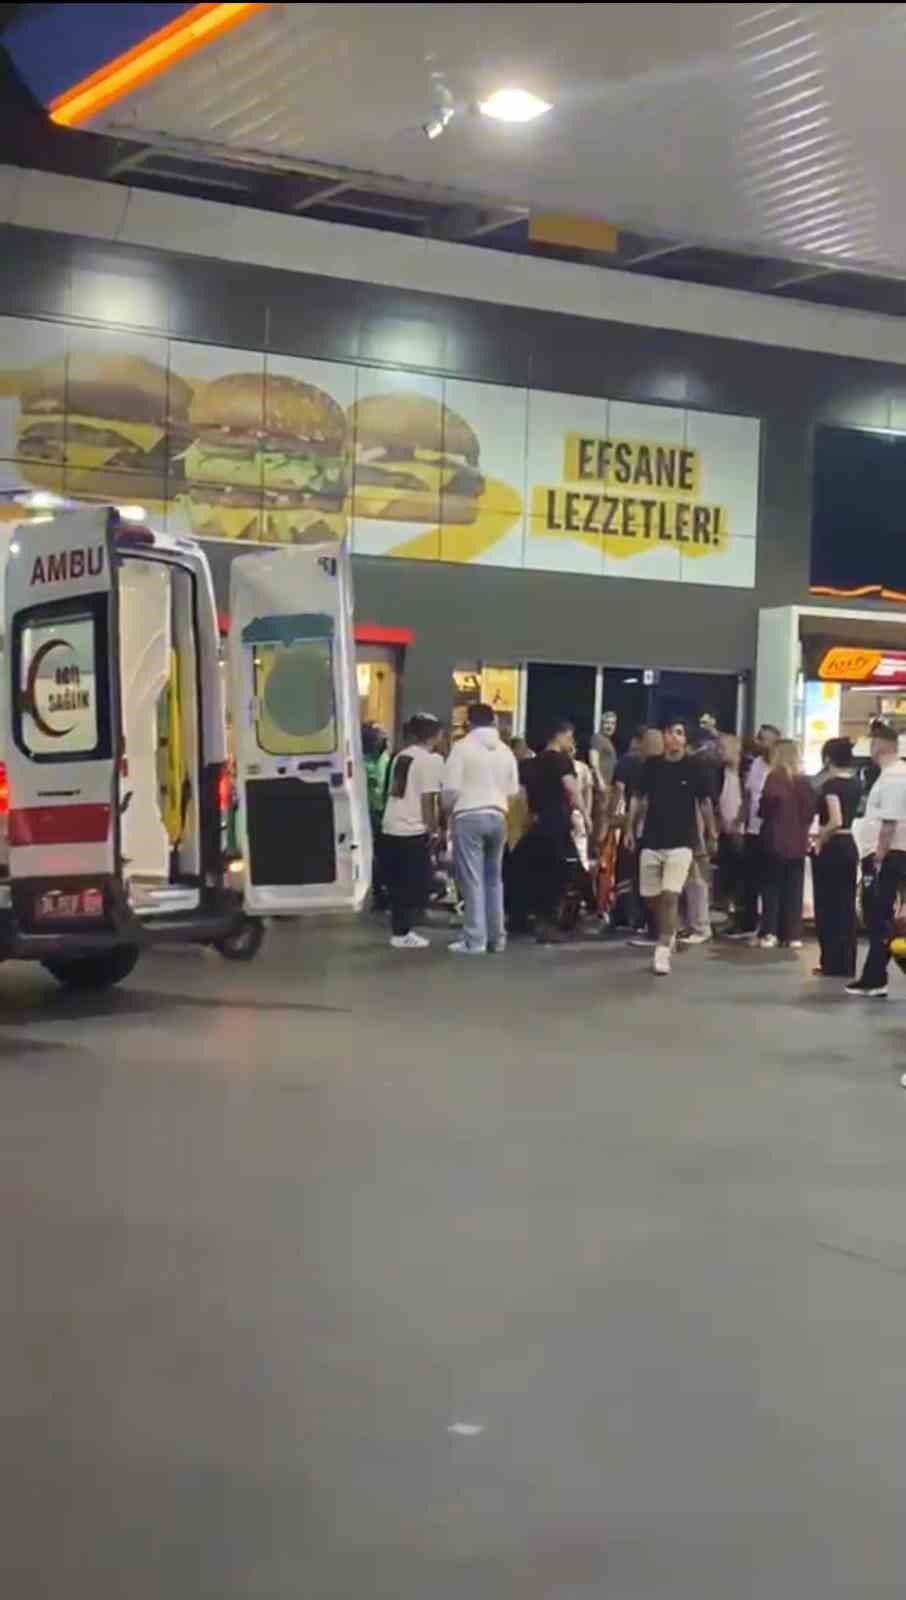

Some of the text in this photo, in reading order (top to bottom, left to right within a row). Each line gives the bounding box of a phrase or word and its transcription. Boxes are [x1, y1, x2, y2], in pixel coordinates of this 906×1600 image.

[578, 438, 694, 490] EFSANE
[546, 489, 721, 546] LEZZETLER!
[29, 545, 104, 587] AMBU
